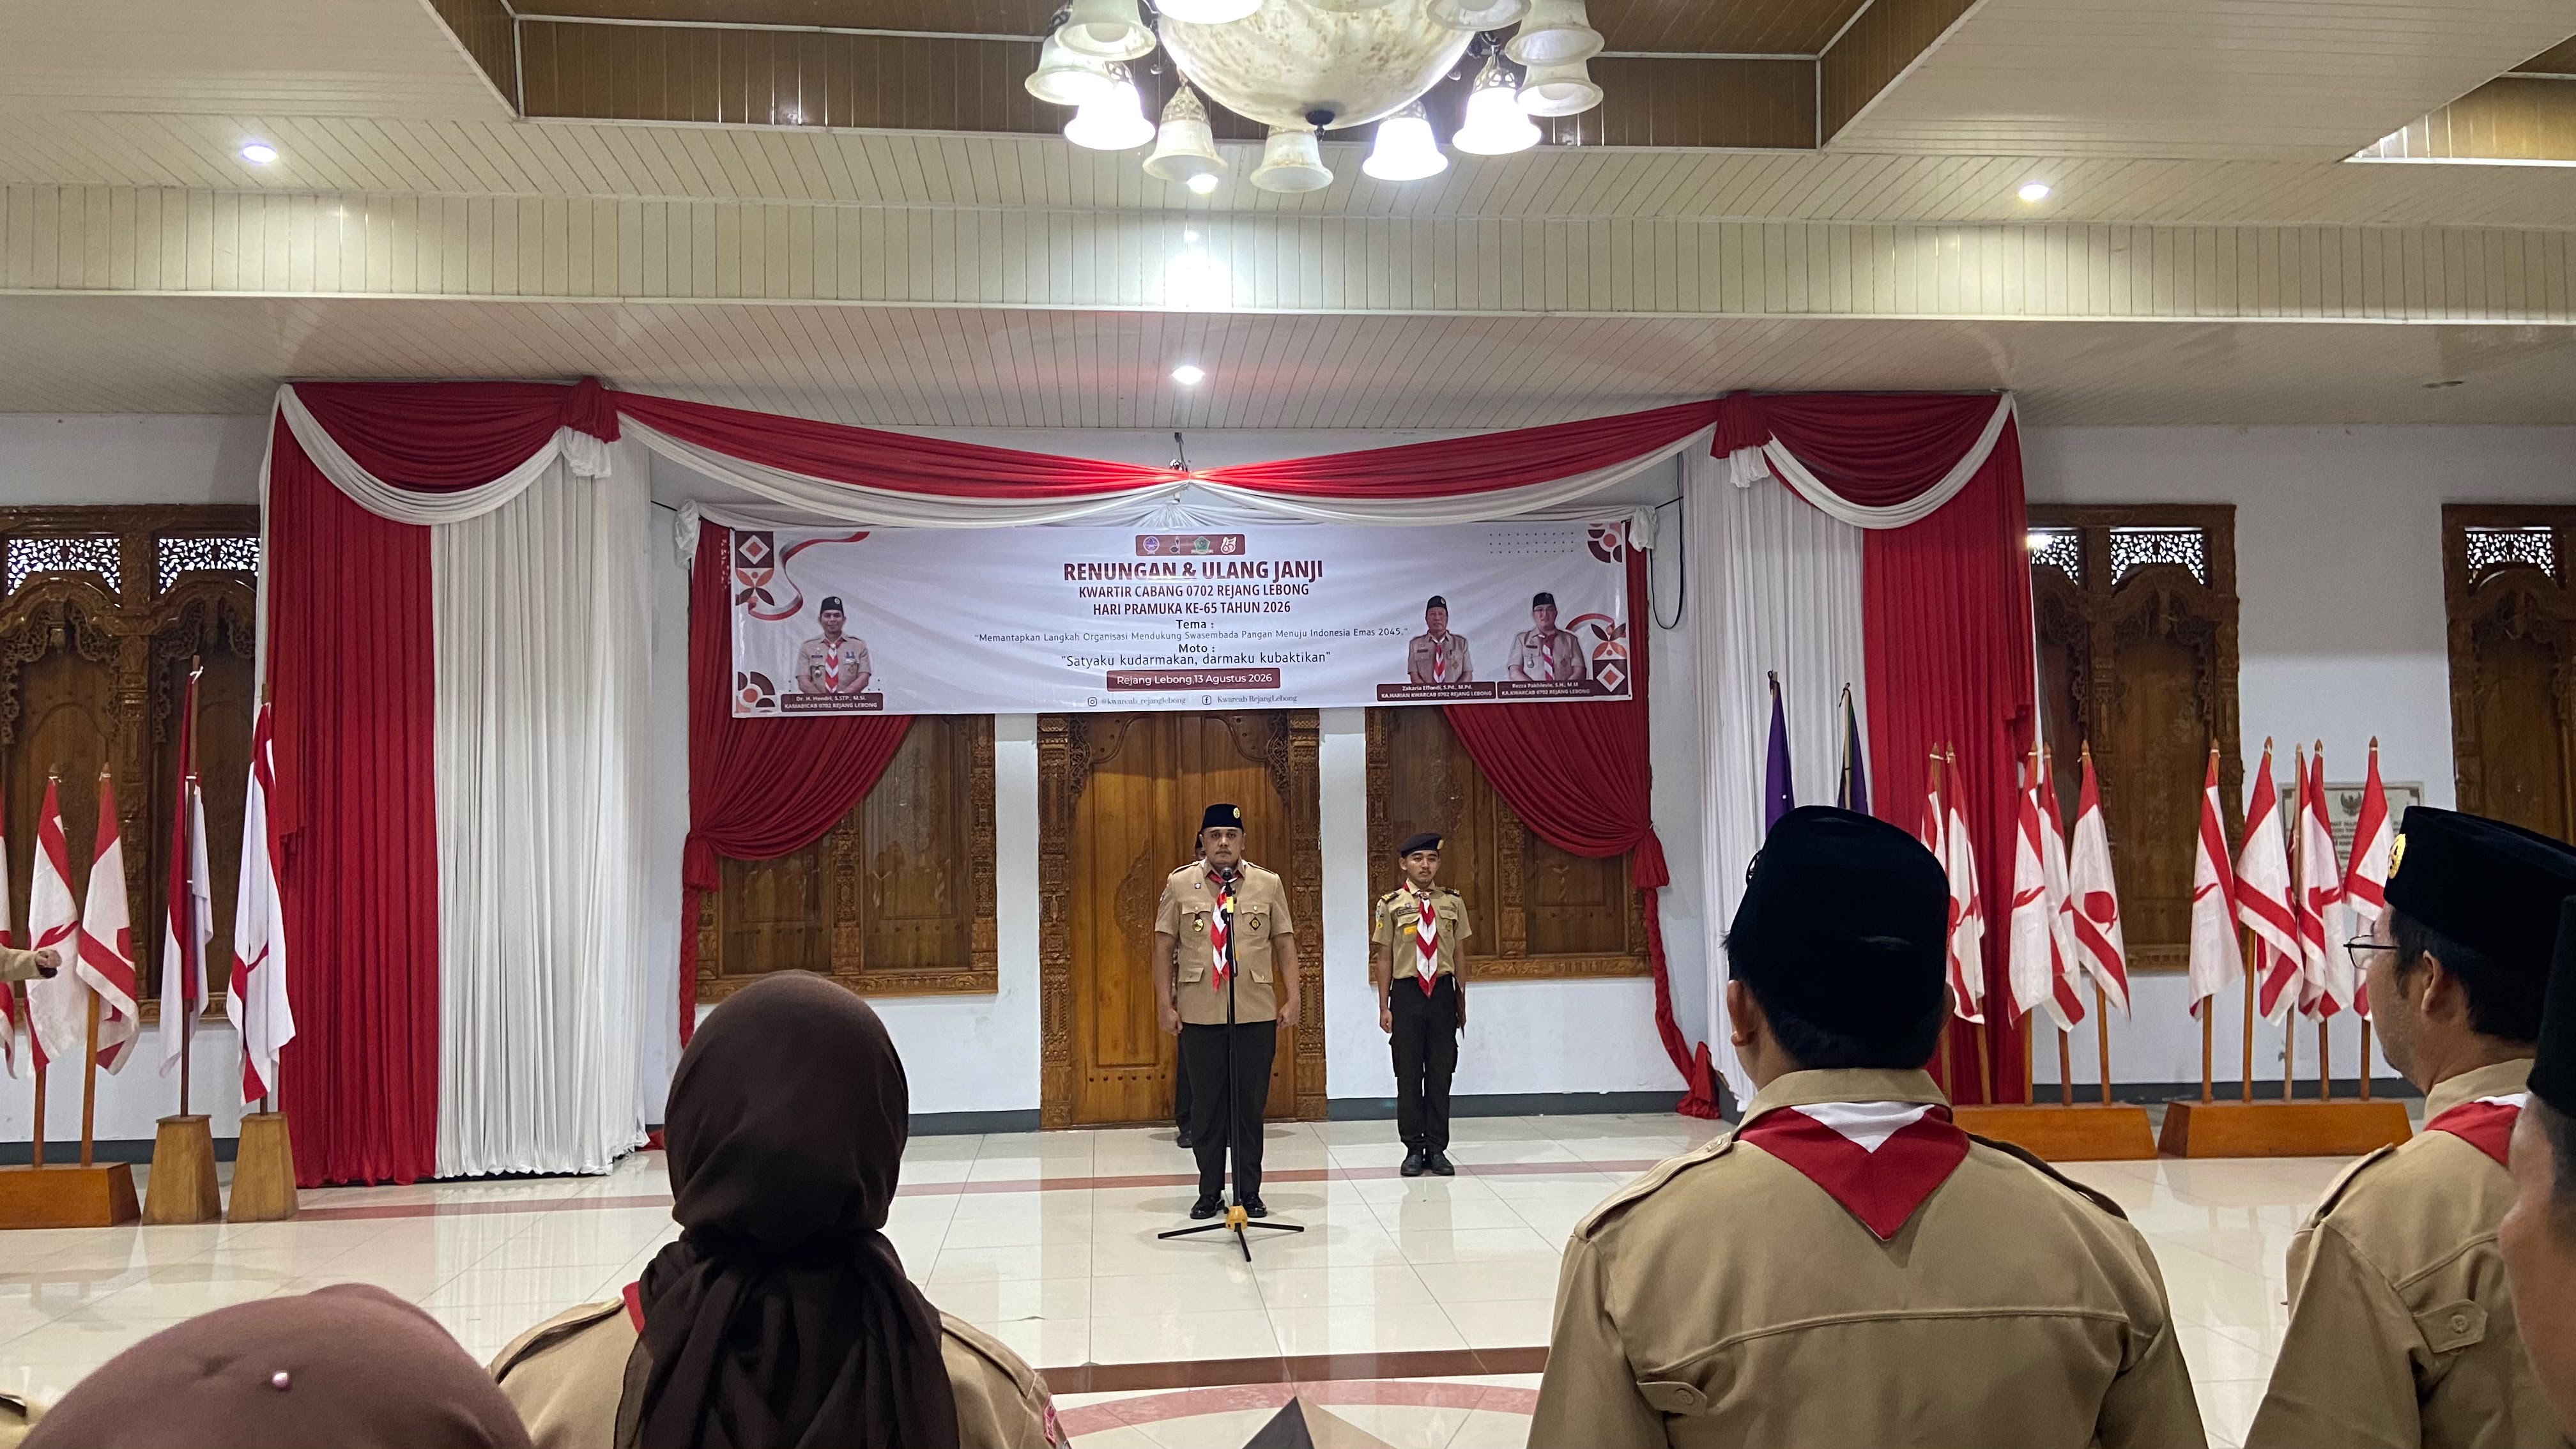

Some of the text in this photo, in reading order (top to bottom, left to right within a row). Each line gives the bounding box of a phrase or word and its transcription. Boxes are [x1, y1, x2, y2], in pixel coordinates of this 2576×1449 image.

[1064, 560, 1323, 583] RENUNGAN & ULANG JANJI
[1079, 583, 1309, 599] KWARTIR CABANG 0702 REJANG LEBONG
[1093, 601, 1291, 615] HARI PRAMUKA KE-65 TAHUN 2026
[1176, 619, 1207, 629] Tema
[1043, 632, 1080, 643] Langkah
[1083, 632, 1128, 641] Organisasi
[1131, 631, 1181, 641] Mendukung
[1184, 631, 1238, 640] Swasembada
[1241, 631, 1273, 640] Pangan
[1275, 629, 1307, 639] Menuju
[1310, 629, 1351, 637] Indonesia
[1353, 629, 1376, 637] Emas
[1178, 644, 1208, 653] Moto
[1061, 651, 1331, 668] "Satyaku kudarmakan, darmaku kubaktikan"
[1117, 673, 1273, 686] Rejang Lebong,13 Agustus 2026
